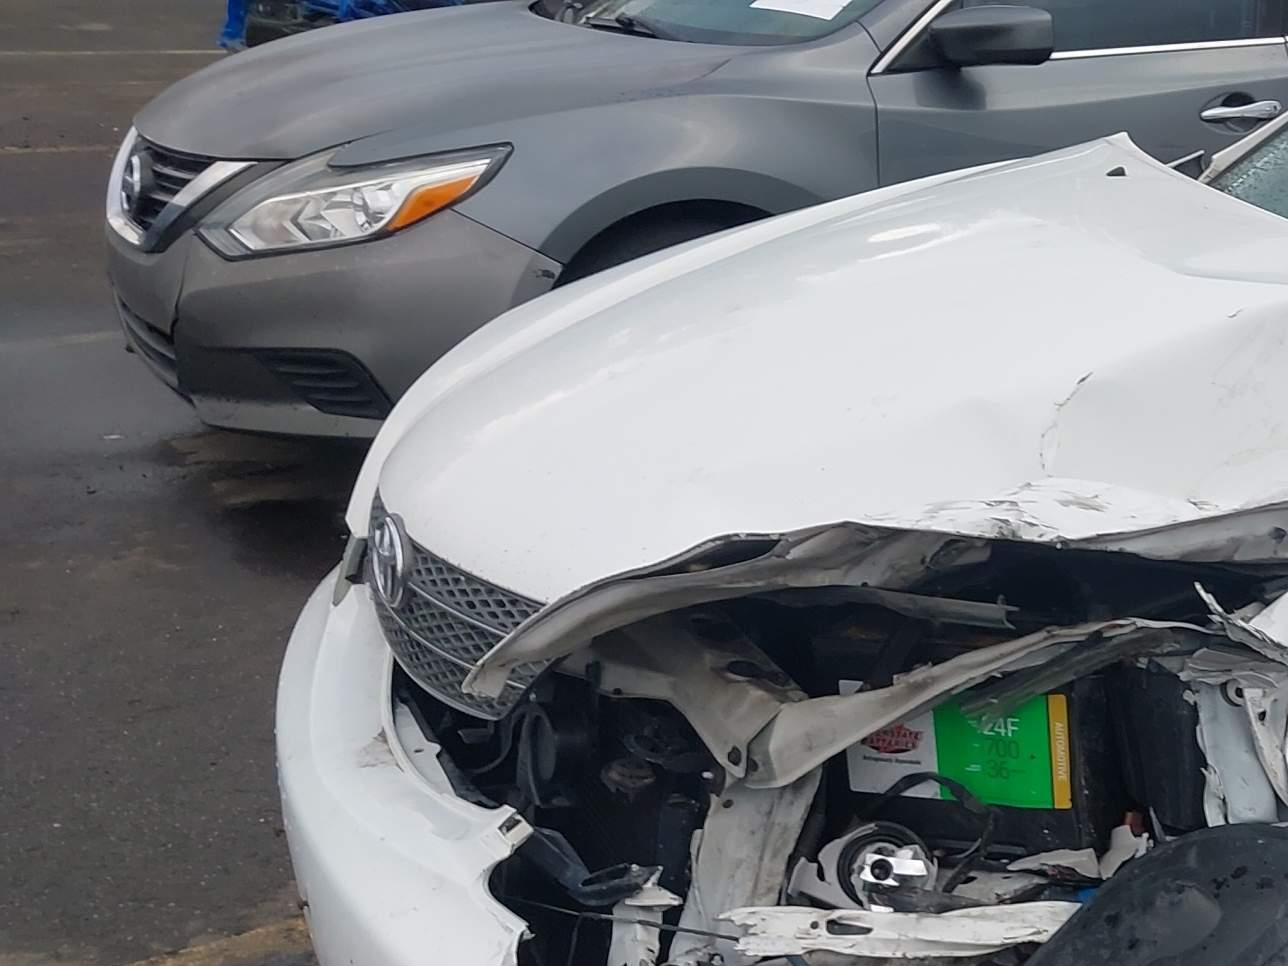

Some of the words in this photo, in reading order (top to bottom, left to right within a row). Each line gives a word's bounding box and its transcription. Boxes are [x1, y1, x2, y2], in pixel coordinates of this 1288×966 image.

[982, 715, 1020, 737] 24F
[986, 739, 1020, 759] 700
[1055, 721, 1067, 782] AUTOMOTIVE
